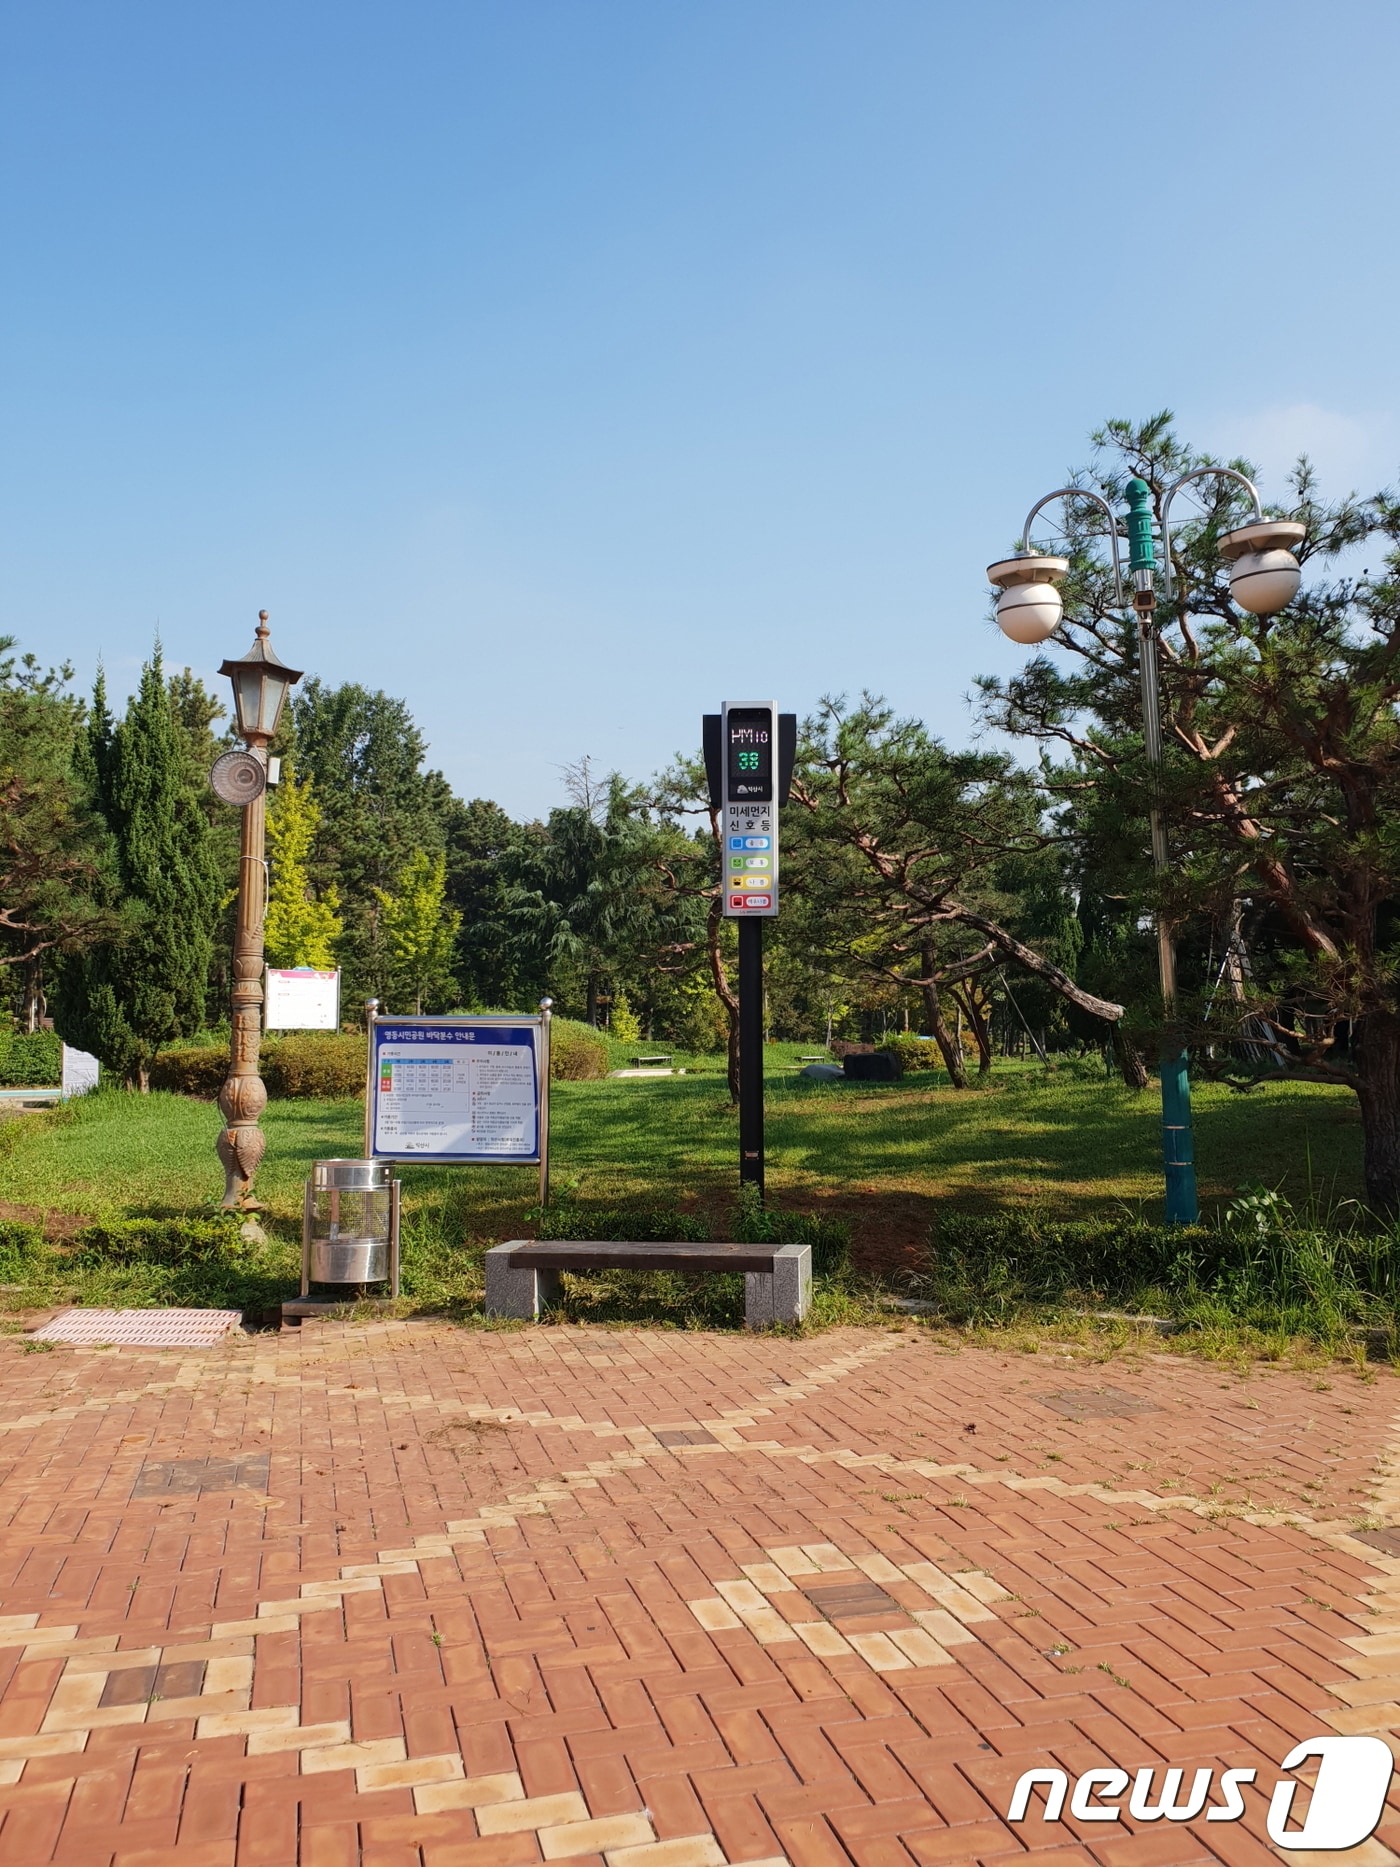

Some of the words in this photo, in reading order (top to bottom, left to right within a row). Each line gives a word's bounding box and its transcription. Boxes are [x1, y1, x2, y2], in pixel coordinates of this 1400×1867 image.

[729, 806, 770, 818] 미세먼지
[384, 1030, 425, 1041] 영등시민공원
[426, 1031, 454, 1041] 바닥분수
[454, 1031, 476, 1041] 안내문
